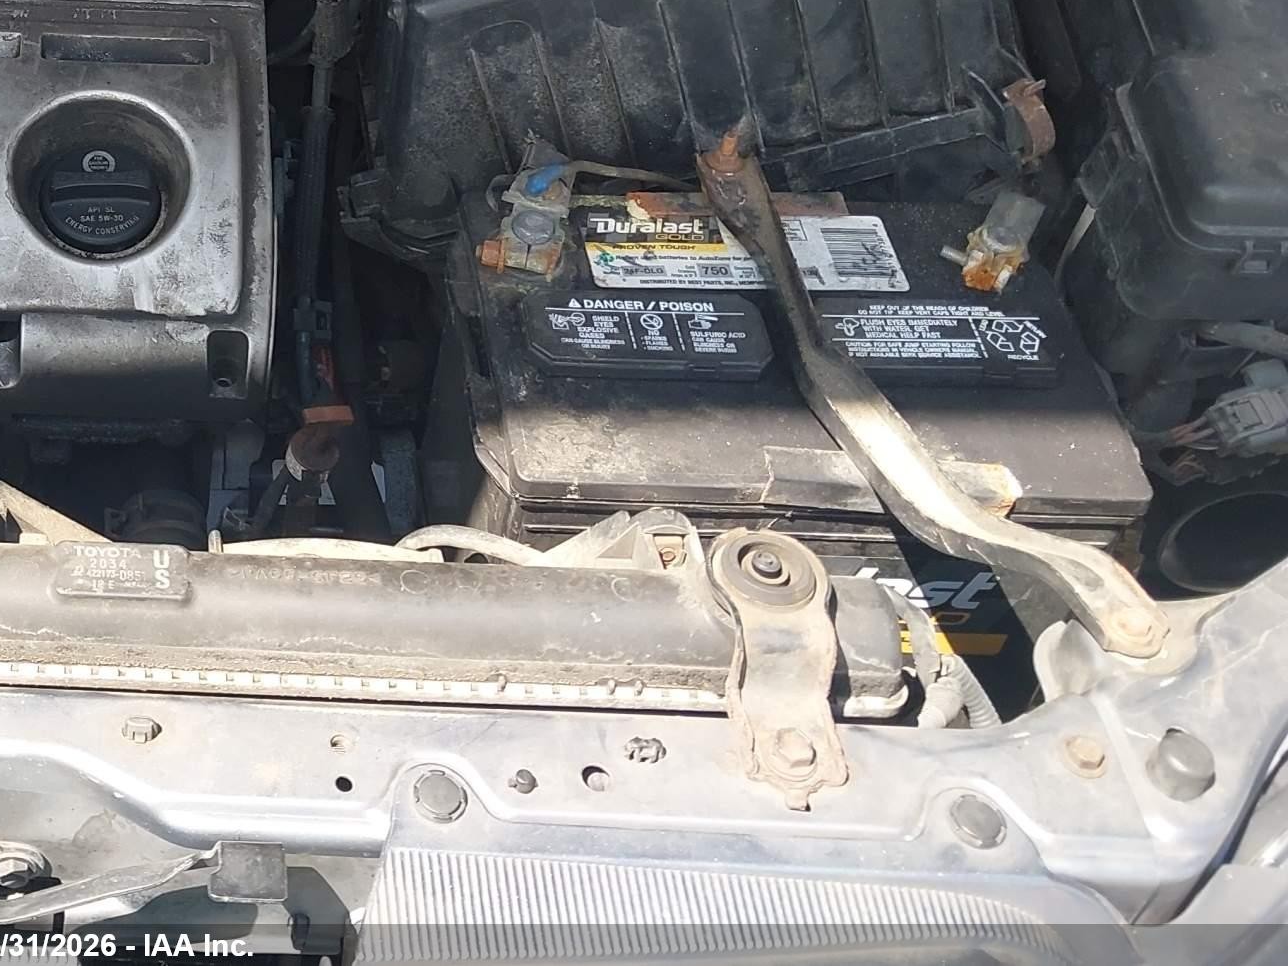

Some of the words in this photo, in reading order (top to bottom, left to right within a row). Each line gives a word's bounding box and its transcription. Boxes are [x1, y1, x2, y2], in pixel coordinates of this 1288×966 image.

[589, 218, 704, 234] Duralast
[701, 266, 729, 276] 750
[583, 299, 645, 310] DANGER
[646, 301, 656, 310] /
[658, 301, 715, 312] POISON
[860, 318, 885, 326] FLUSH
[73, 545, 142, 558] TOYOTA
[89, 558, 127, 569] 2034
